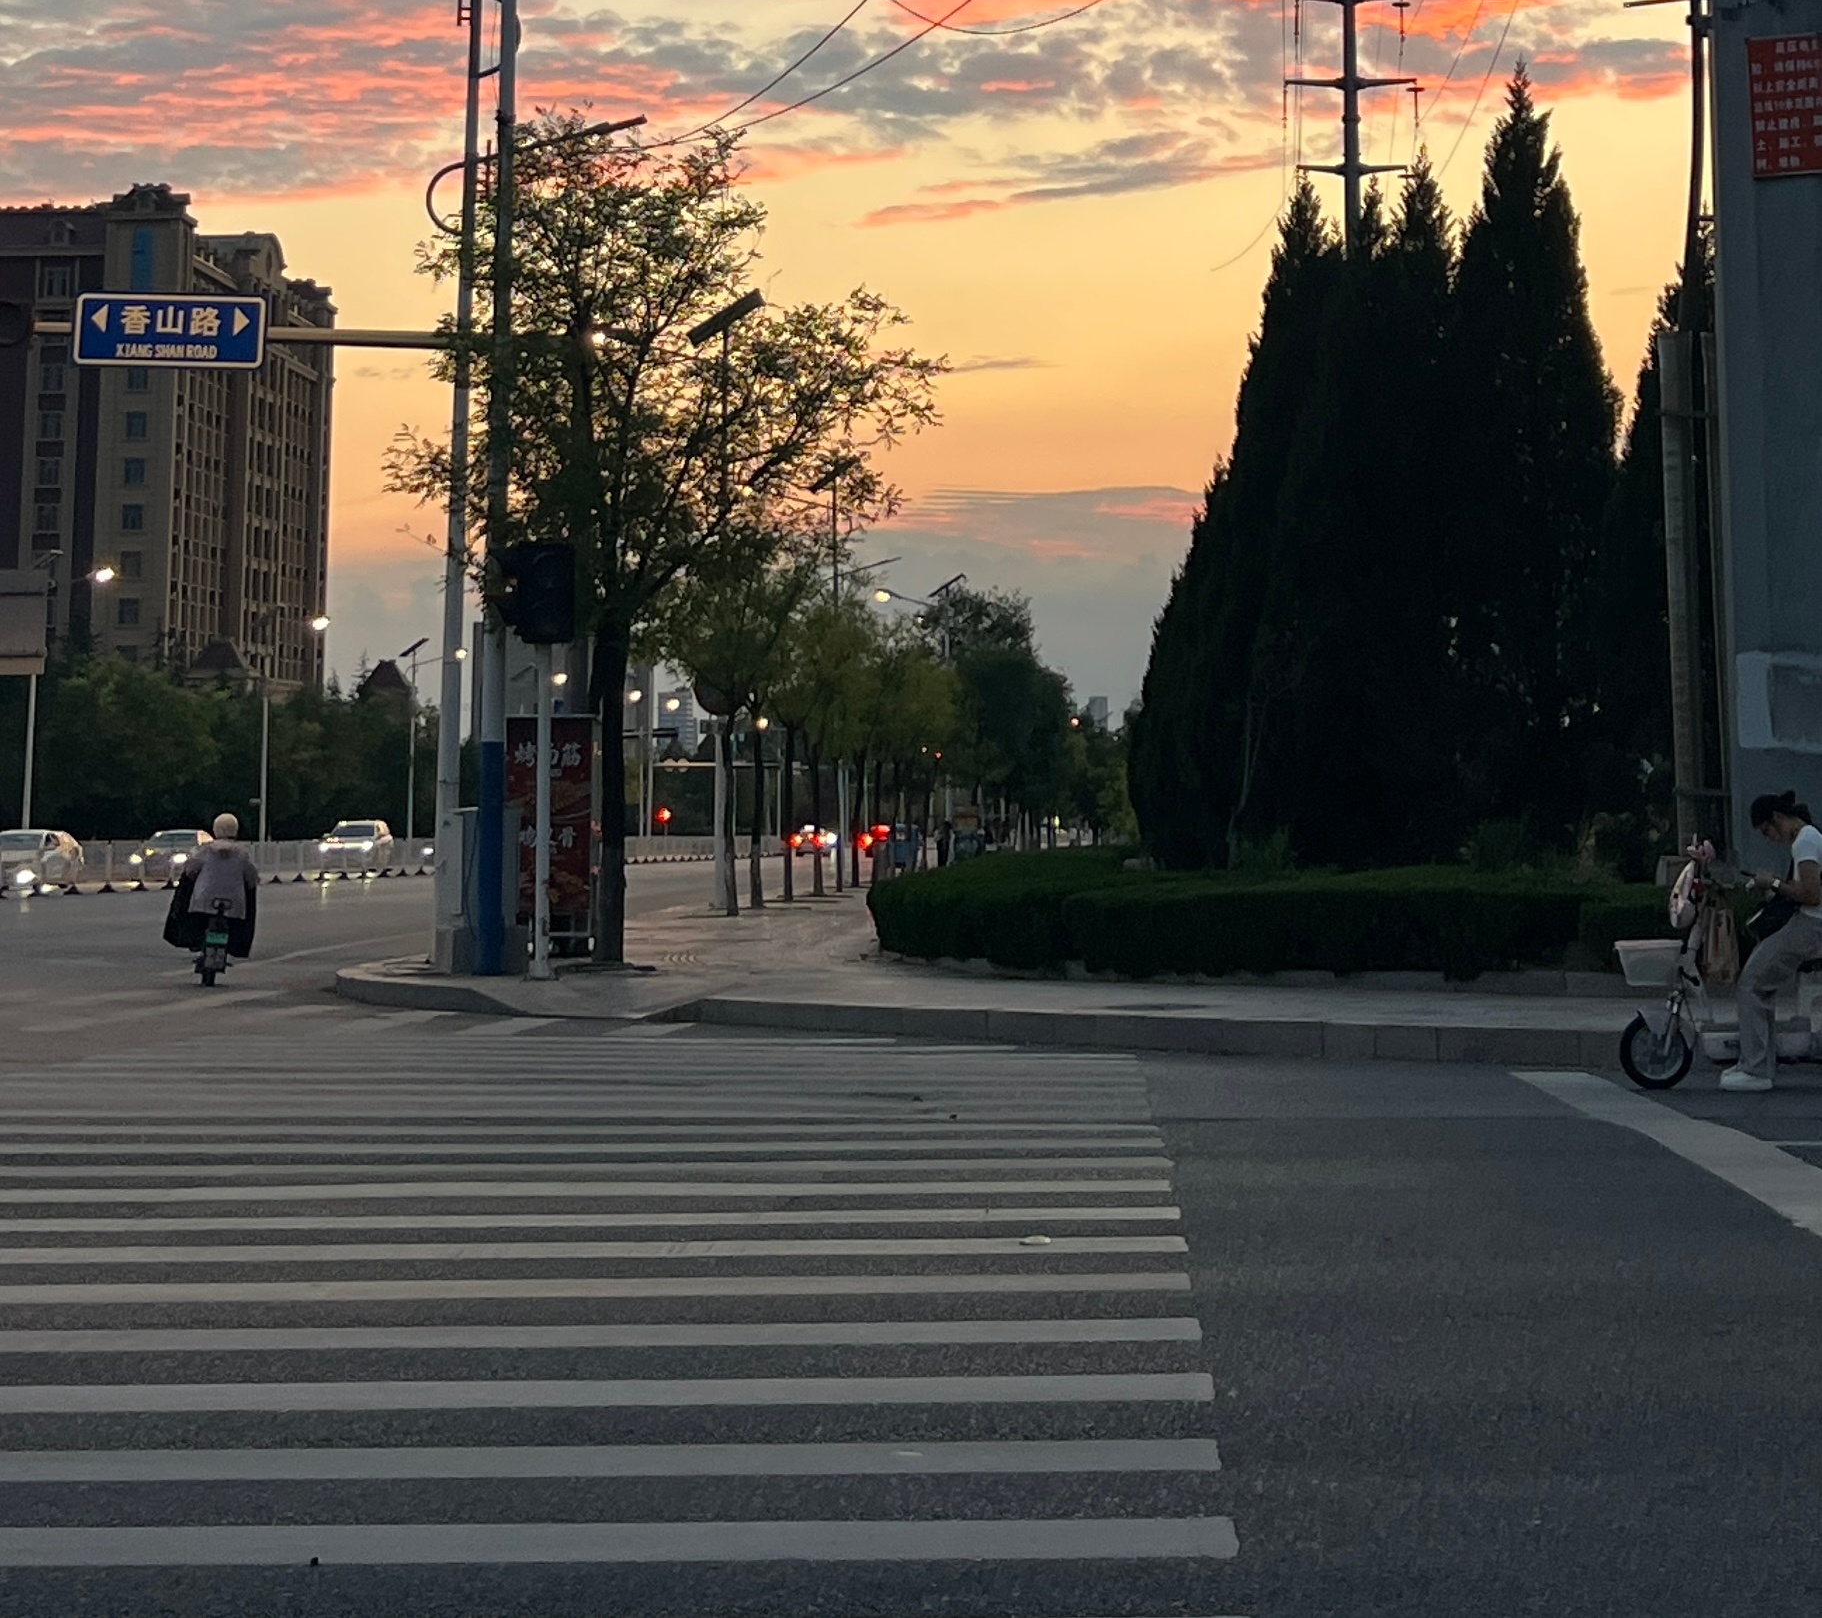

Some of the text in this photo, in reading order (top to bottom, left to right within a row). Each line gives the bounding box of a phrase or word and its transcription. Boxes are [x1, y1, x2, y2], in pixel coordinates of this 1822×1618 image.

[121, 305, 221, 336] 香山路
[115, 343, 218, 359] XIANG SHAN ROAD
